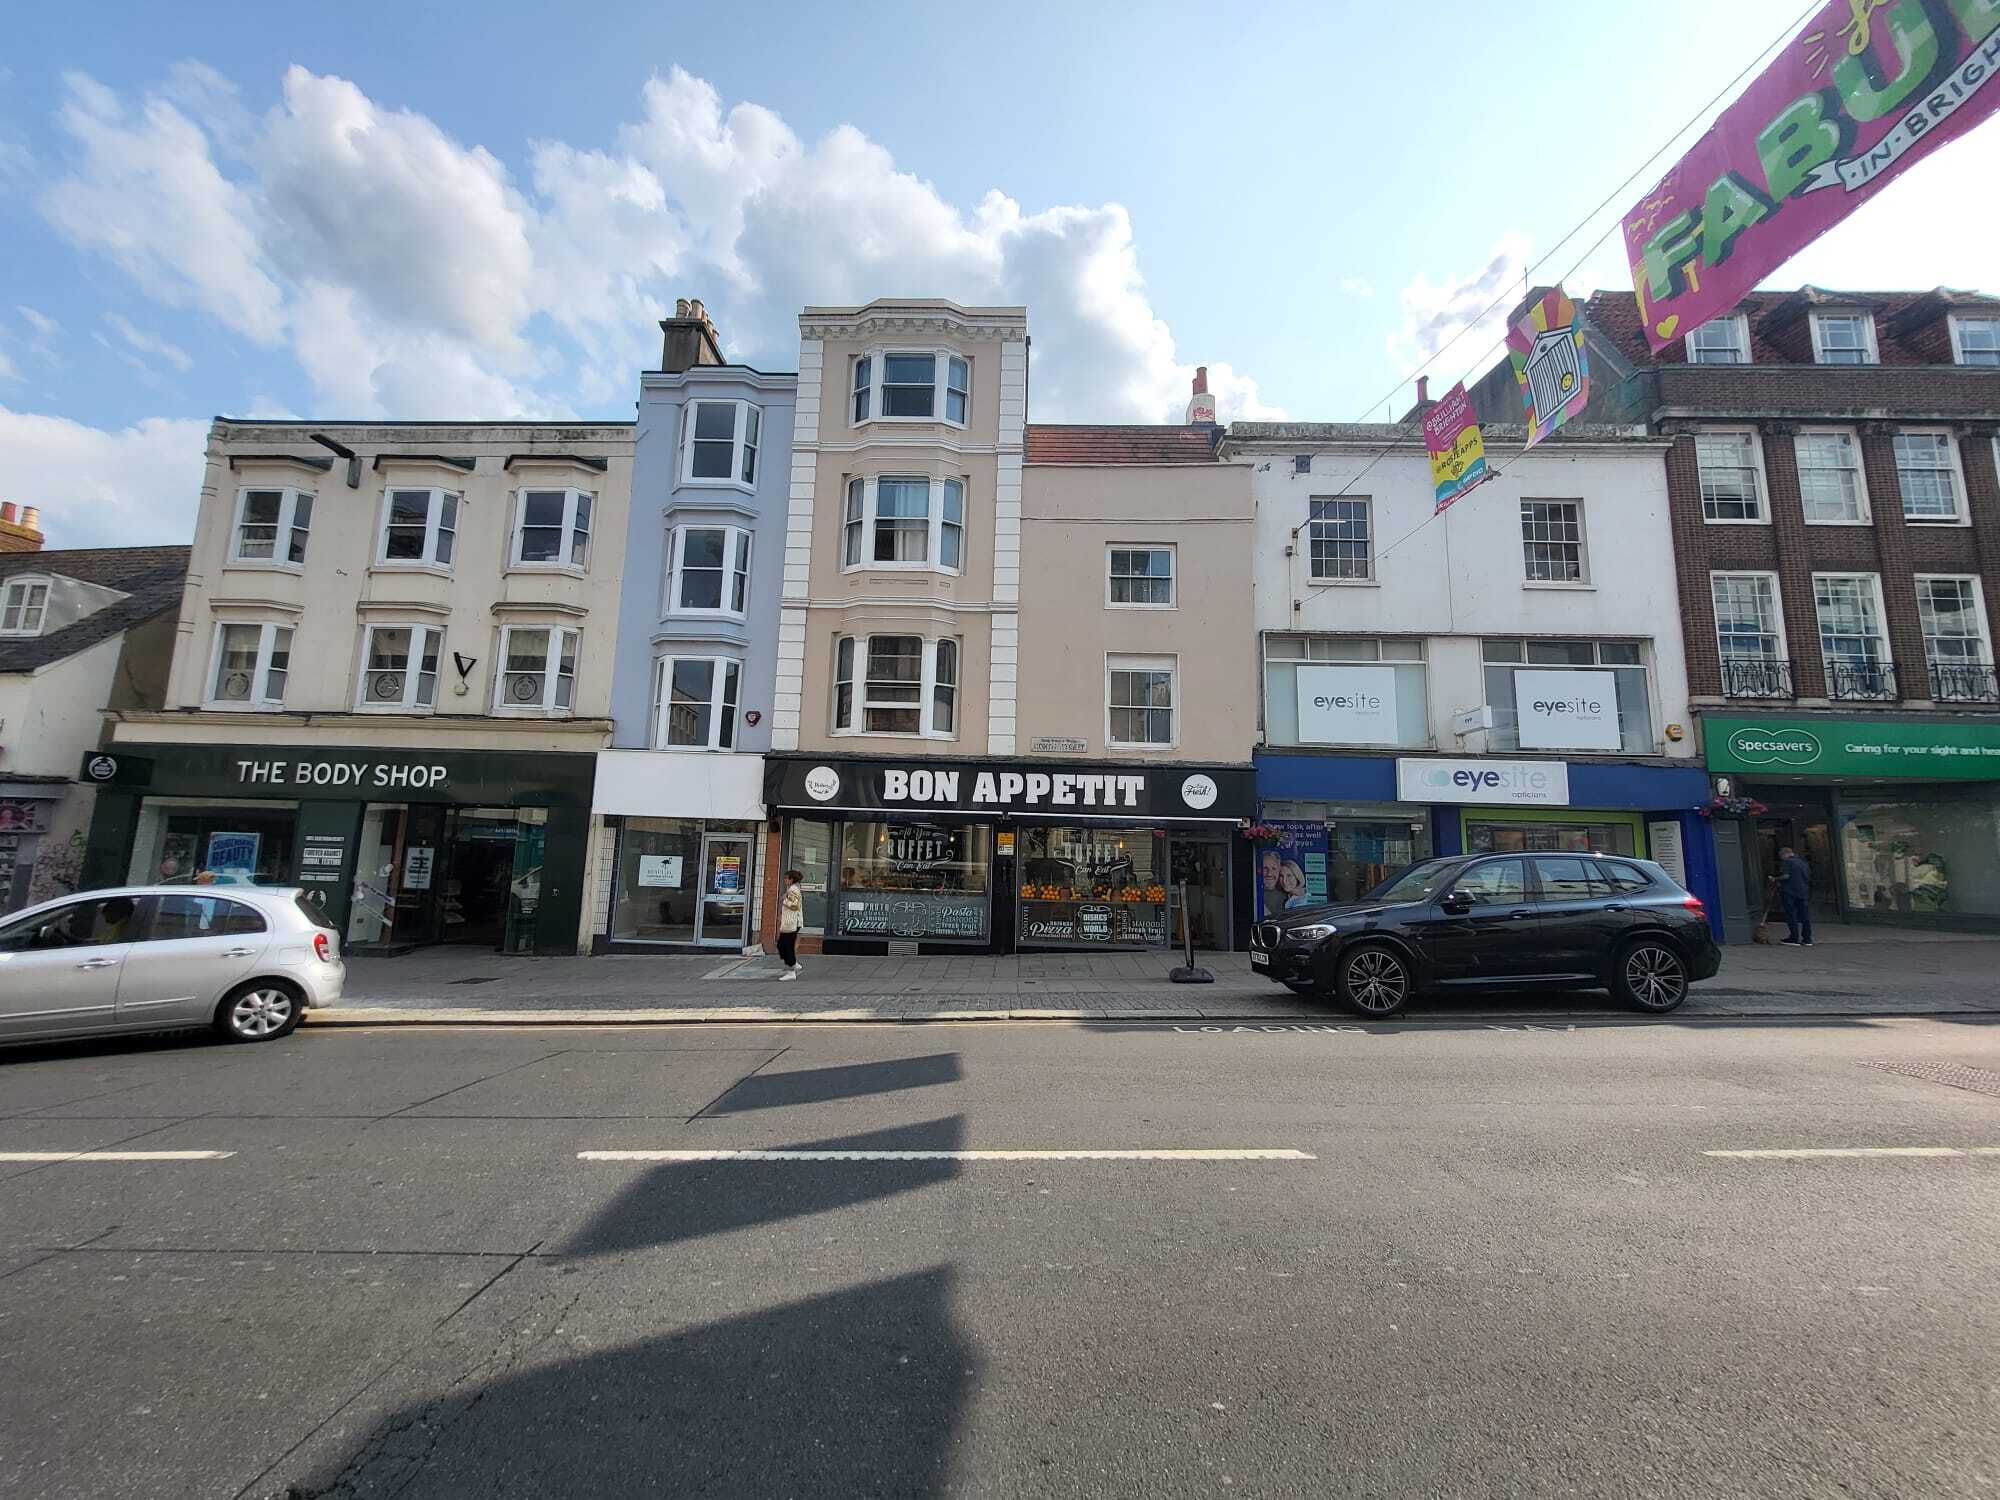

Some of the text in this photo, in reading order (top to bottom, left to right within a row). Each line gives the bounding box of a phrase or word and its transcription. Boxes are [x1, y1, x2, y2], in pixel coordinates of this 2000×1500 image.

[1433, 402, 1468, 436] BRIGHTON
[1313, 693, 1380, 711] eyesite
[1533, 698, 1601, 716] eyesite
[1738, 740, 1812, 752] Specsavers
[1845, 744, 1881, 755] Caring
[1884, 744, 1900, 753] for
[1902, 746, 1928, 755] your
[1930, 745, 1958, 757] sight
[1960, 747, 1979, 755] and
[237, 761, 447, 787] THE BODY SHOP
[1453, 766, 1547, 791] eyesite
[884, 770, 1145, 806] BON APPETIT
[1512, 791, 1547, 799] opticians
[887, 839, 943, 860] BUFFET
[941, 906, 973, 920] Pasta
[846, 917, 887, 932] Pizza
[1030, 922, 1072, 937] Pizza
[1083, 925, 1108, 933] WORLD
[1172, 1026, 1368, 1034] LOADING
